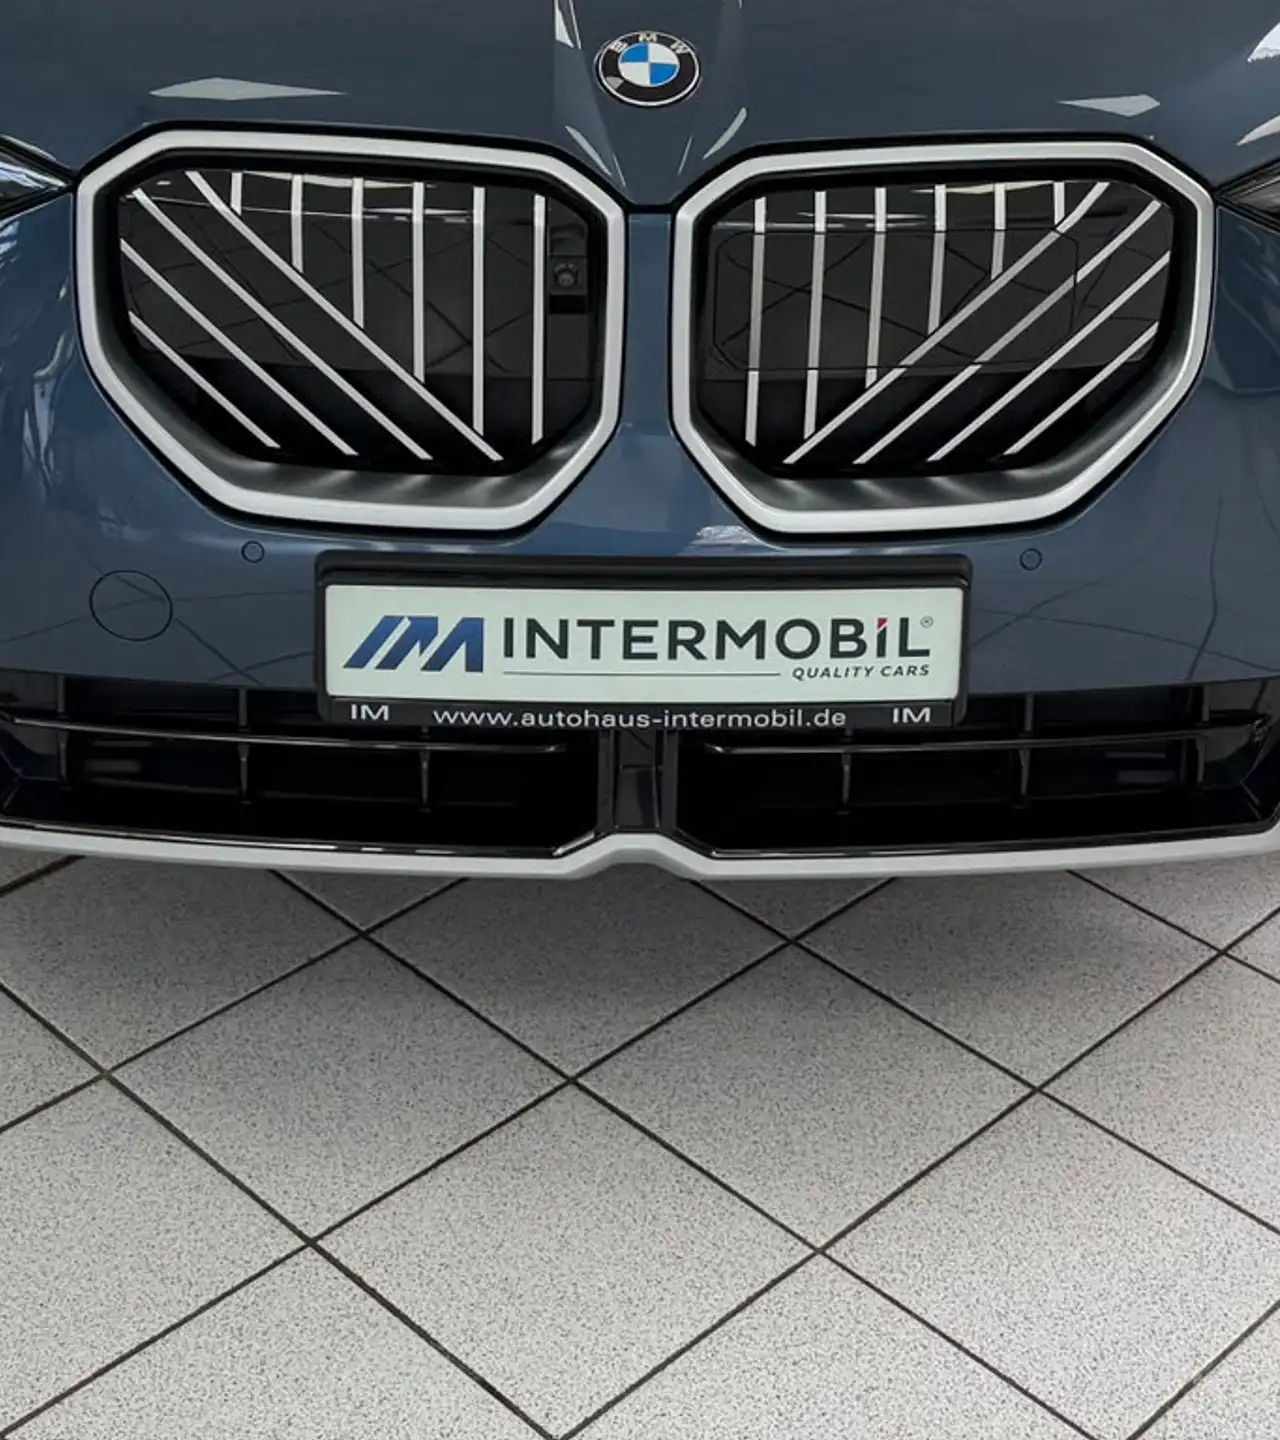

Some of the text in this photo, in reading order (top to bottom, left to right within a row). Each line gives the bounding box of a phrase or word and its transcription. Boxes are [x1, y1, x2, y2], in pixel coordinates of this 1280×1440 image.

[609, 30, 690, 54] BMW
[791, 664, 930, 682] QUALITY CARS
[350, 703, 932, 729] IM www.autohaus-intermobil.de IM
